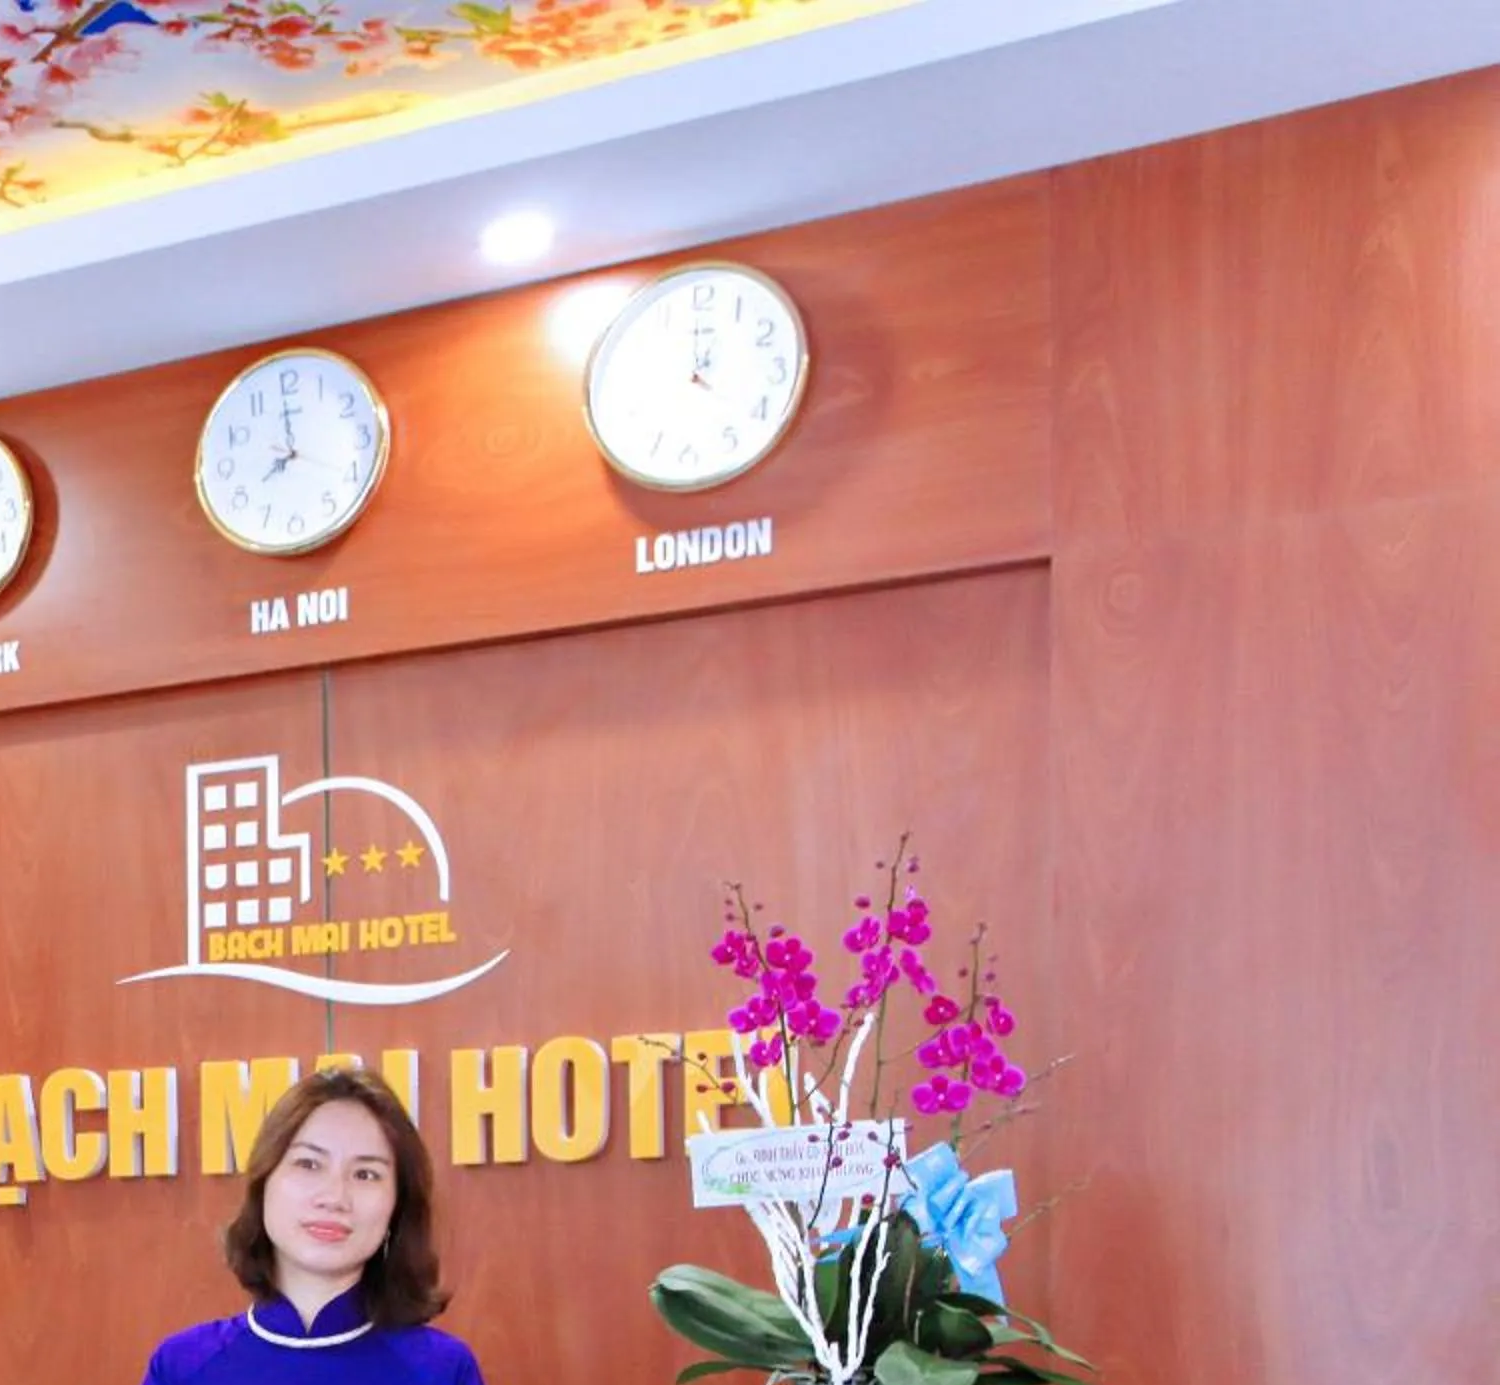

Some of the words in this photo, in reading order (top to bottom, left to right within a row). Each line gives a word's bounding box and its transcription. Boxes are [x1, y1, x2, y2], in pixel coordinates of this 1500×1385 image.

[756, 318, 775, 347] 2
[279, 369, 299, 396] 12
[767, 356, 788, 385] 3
[250, 391, 264, 417] 11
[339, 393, 355, 419] 2
[228, 424, 251, 449] 10
[357, 423, 371, 449] 3
[217, 457, 235, 480] 9
[342, 460, 358, 482] 4
[231, 485, 249, 511] 8
[322, 491, 337, 517] 5
[259, 503, 272, 529] 7
[287, 514, 305, 536] 6
[635, 517, 773, 573] LONDON
[251, 596, 290, 634] HA
[297, 586, 348, 627] NOI
[208, 928, 284, 961] BACH
[291, 922, 350, 955] MAI
[359, 911, 456, 950] HOTEL
